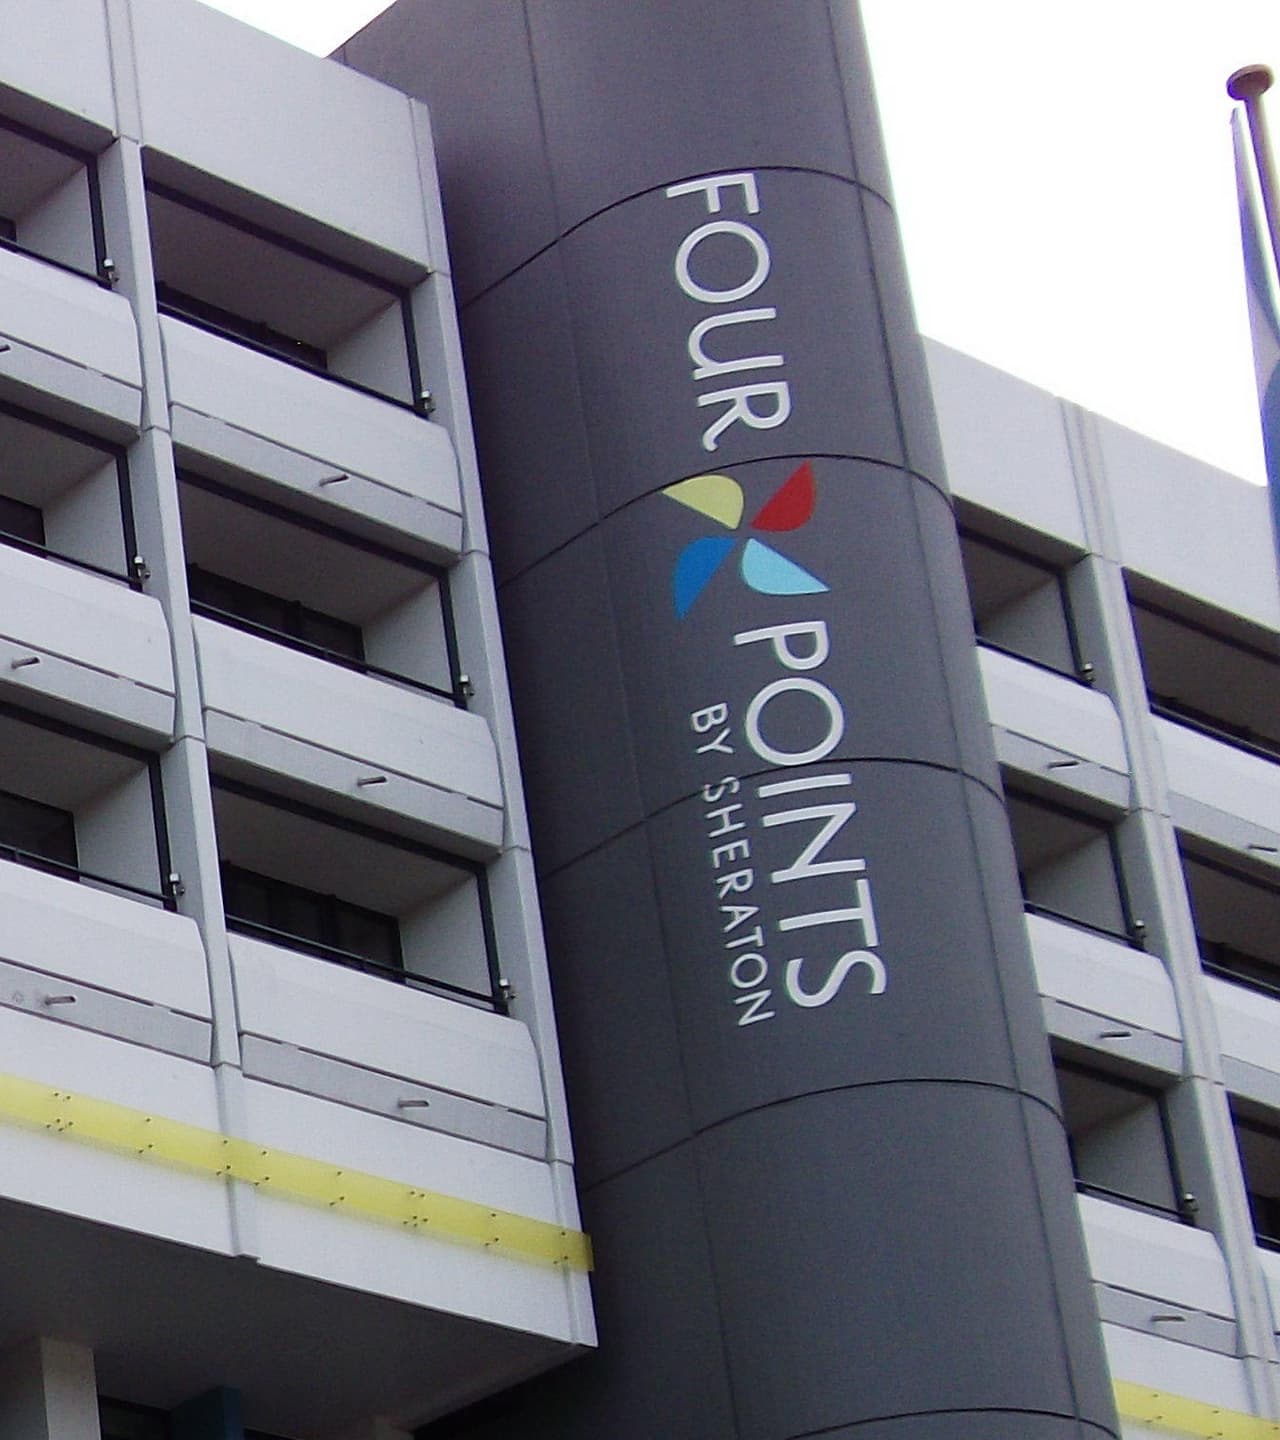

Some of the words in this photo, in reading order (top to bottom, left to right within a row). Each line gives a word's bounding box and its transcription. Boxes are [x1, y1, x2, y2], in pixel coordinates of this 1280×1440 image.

[666, 172, 792, 451] FOUR
[733, 620, 887, 1009] POINTS
[690, 701, 736, 756] BY
[702, 776, 775, 1029] SHERATON
